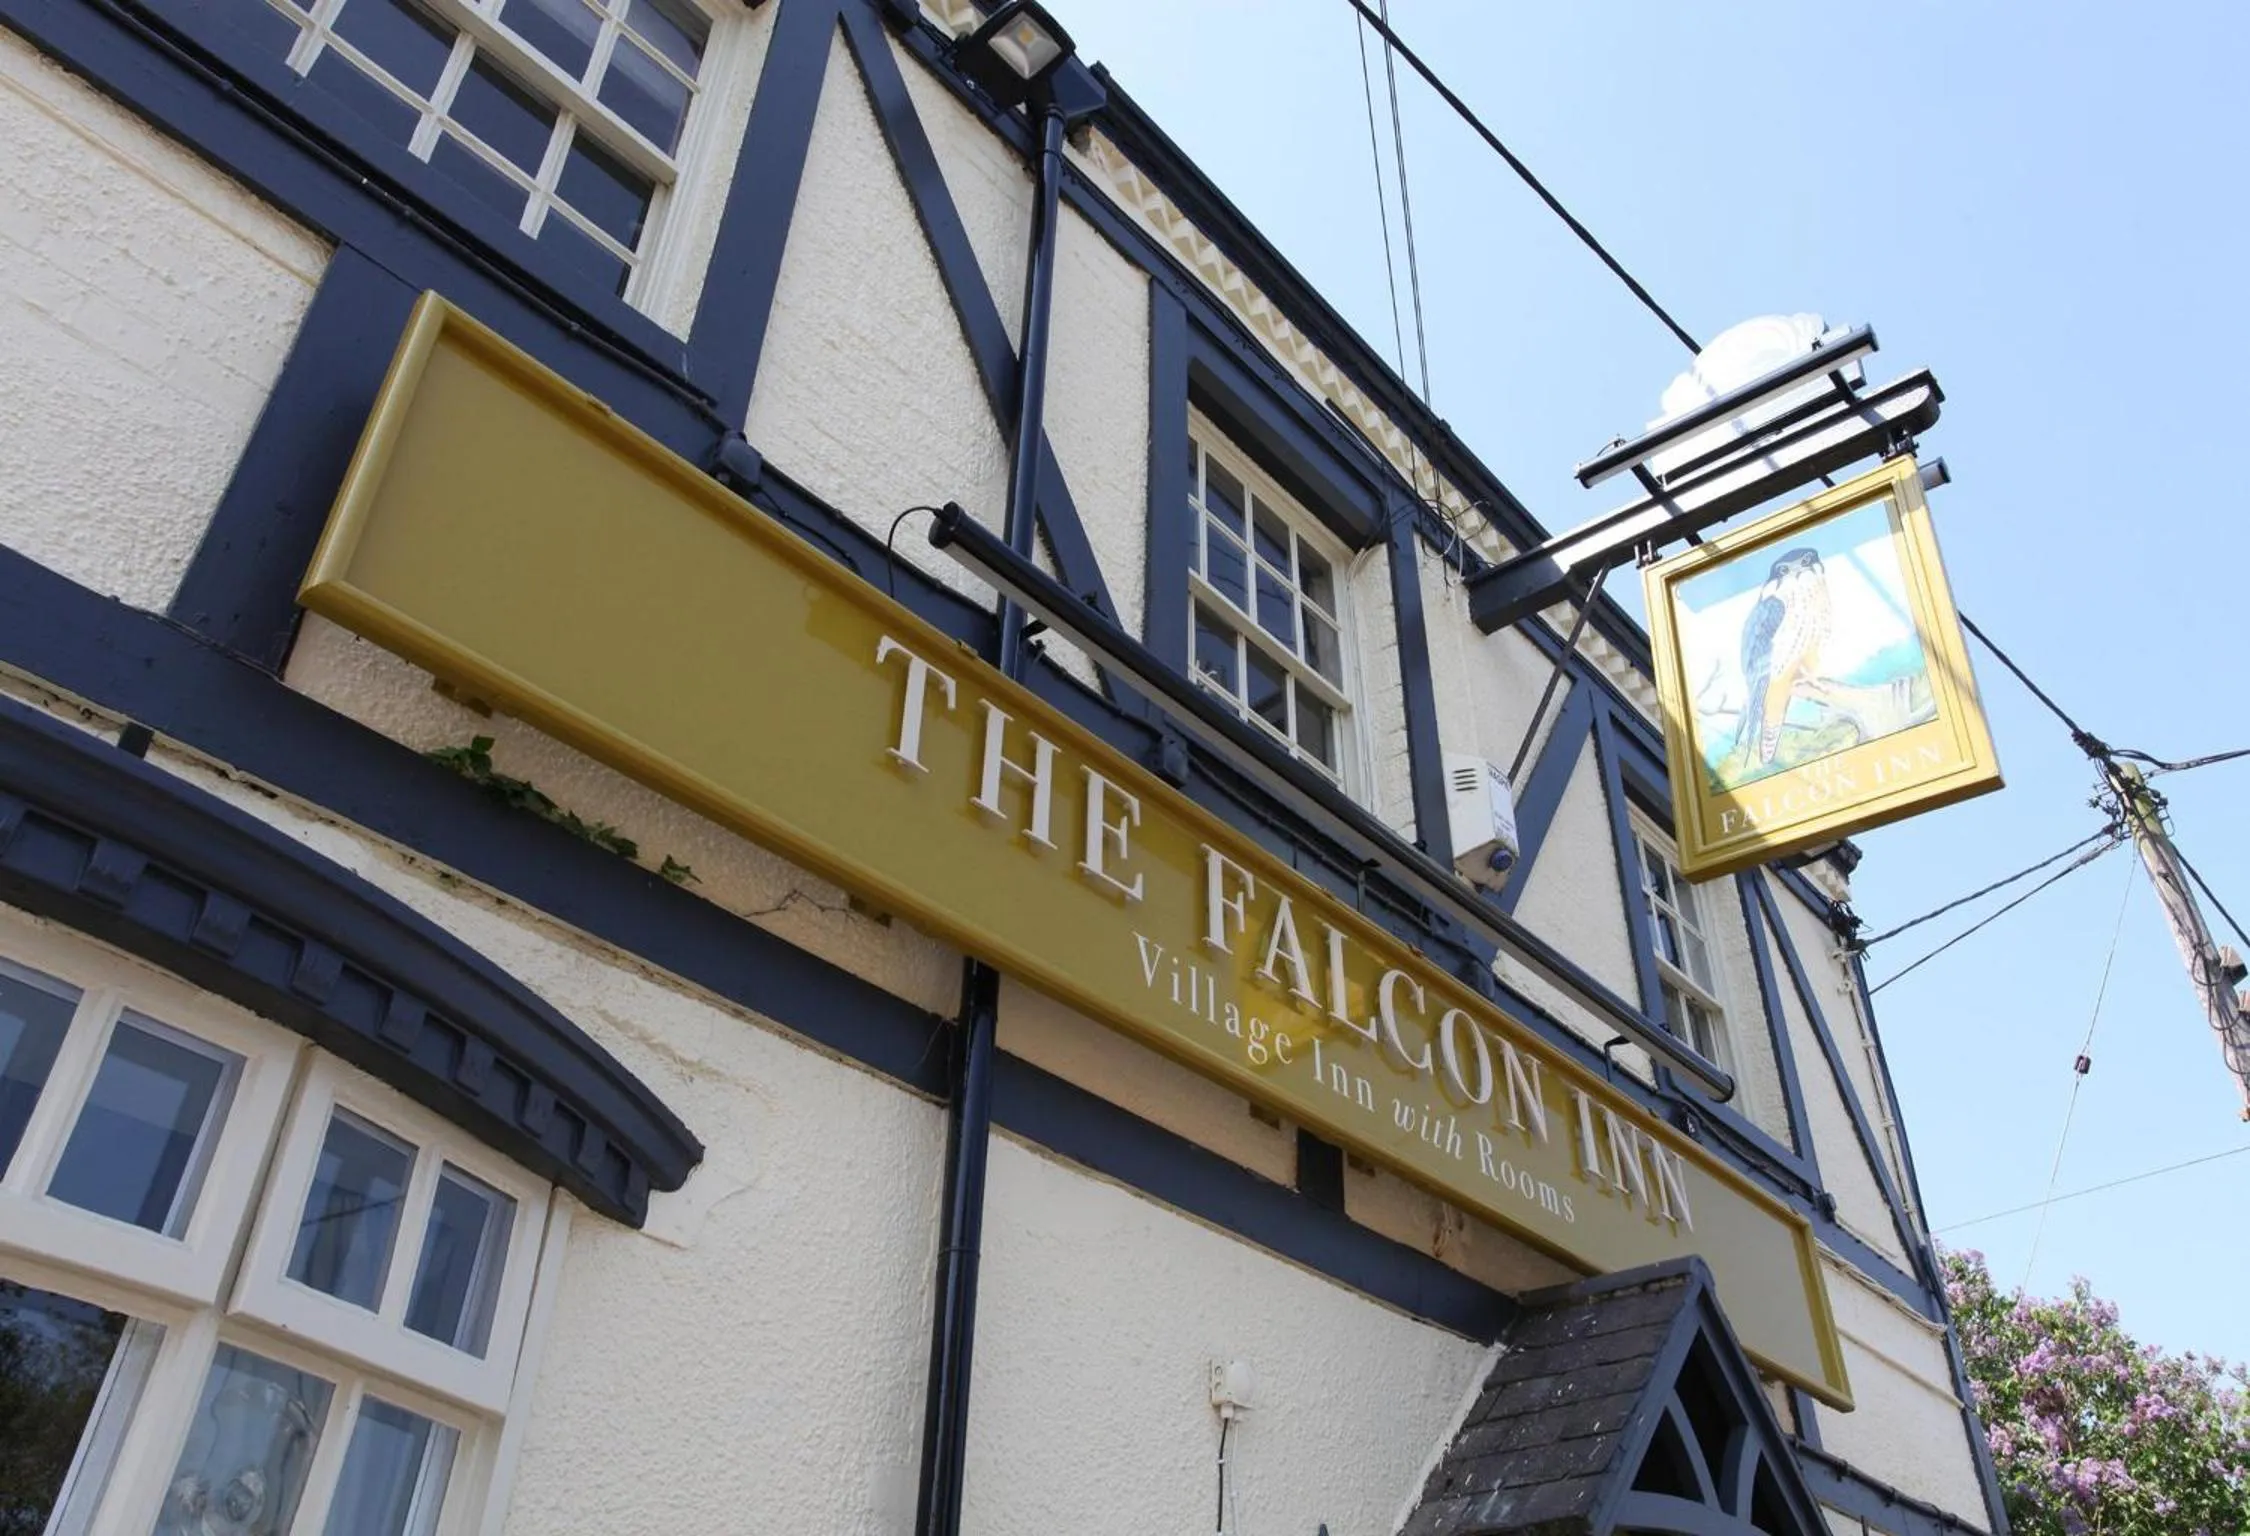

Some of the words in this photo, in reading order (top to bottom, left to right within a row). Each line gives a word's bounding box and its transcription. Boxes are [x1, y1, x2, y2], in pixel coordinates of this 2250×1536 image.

[876, 634, 1144, 901] THE
[1201, 842, 1549, 1144] FALCON
[1572, 1086, 1695, 1234] INN
[1719, 772, 1858, 835] FALCON
[1872, 743, 1943, 783] INN
[1132, 931, 1294, 1065] Village
[1311, 1035, 1376, 1113] Inn
[1392, 1098, 1464, 1161] with
[1475, 1130, 1576, 1225] Rooms
